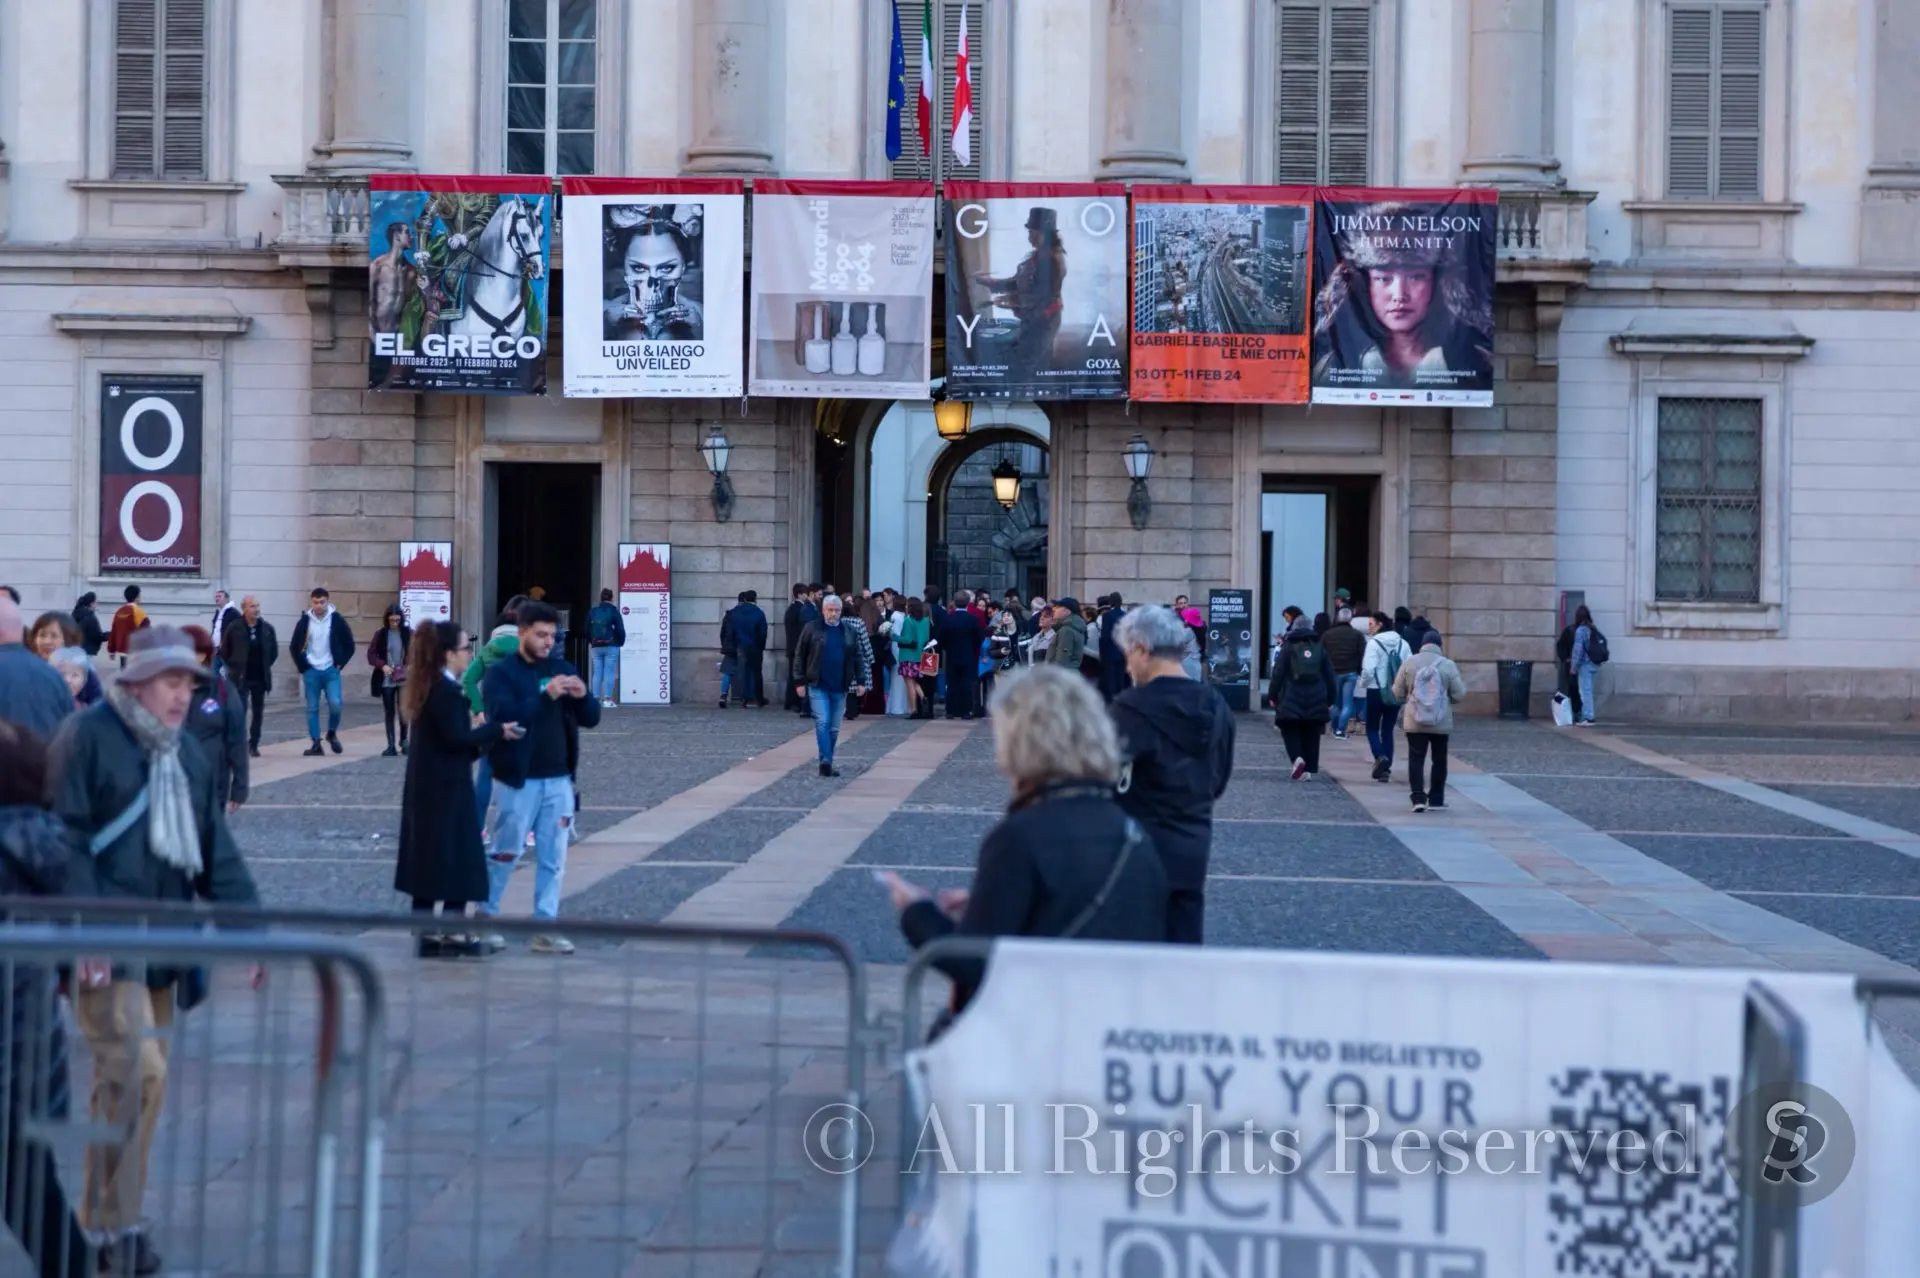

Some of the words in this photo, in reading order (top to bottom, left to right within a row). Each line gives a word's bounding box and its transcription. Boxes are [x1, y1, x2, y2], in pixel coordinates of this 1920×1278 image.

[1332, 215, 1395, 235] JIMMY
[1401, 216, 1481, 232] NELSON
[809, 200, 829, 291] Morandi
[1360, 237, 1455, 250] HUMANITY
[856, 242, 876, 292] 1964
[375, 332, 415, 356] EL
[421, 334, 541, 360] GRECO
[1134, 335, 1201, 347] GABRIELE
[1203, 336, 1266, 348] BASILICO
[602, 345, 641, 357] LUIGI
[657, 345, 705, 358] IANGO
[1221, 349, 1237, 359] LE
[1240, 349, 1264, 360] MIE
[400, 357, 428, 366] OTTOBRE
[430, 357, 448, 366] 2023
[464, 359, 497, 368] FEBBRAIO
[499, 359, 518, 368] 2024
[616, 358, 691, 371] UNVEILED
[1086, 359, 1121, 369] GOYA
[1134, 368, 1148, 379] 13
[1196, 369, 1222, 381] FEB
[1224, 370, 1241, 381] 24
[659, 593, 668, 630] MUSEO
[659, 634, 668, 653] DEL
[659, 656, 668, 700] DUOMO
[1103, 1027, 1235, 1059] ACQUISTA
[1241, 1035, 1266, 1060] IL
[1273, 1037, 1332, 1065] TUO
[1338, 1040, 1482, 1073] BIGLIETTO
[1104, 1058, 1235, 1112] BUY
[1278, 1066, 1478, 1128] YOUR
[1103, 1116, 1480, 1237] TICKET
